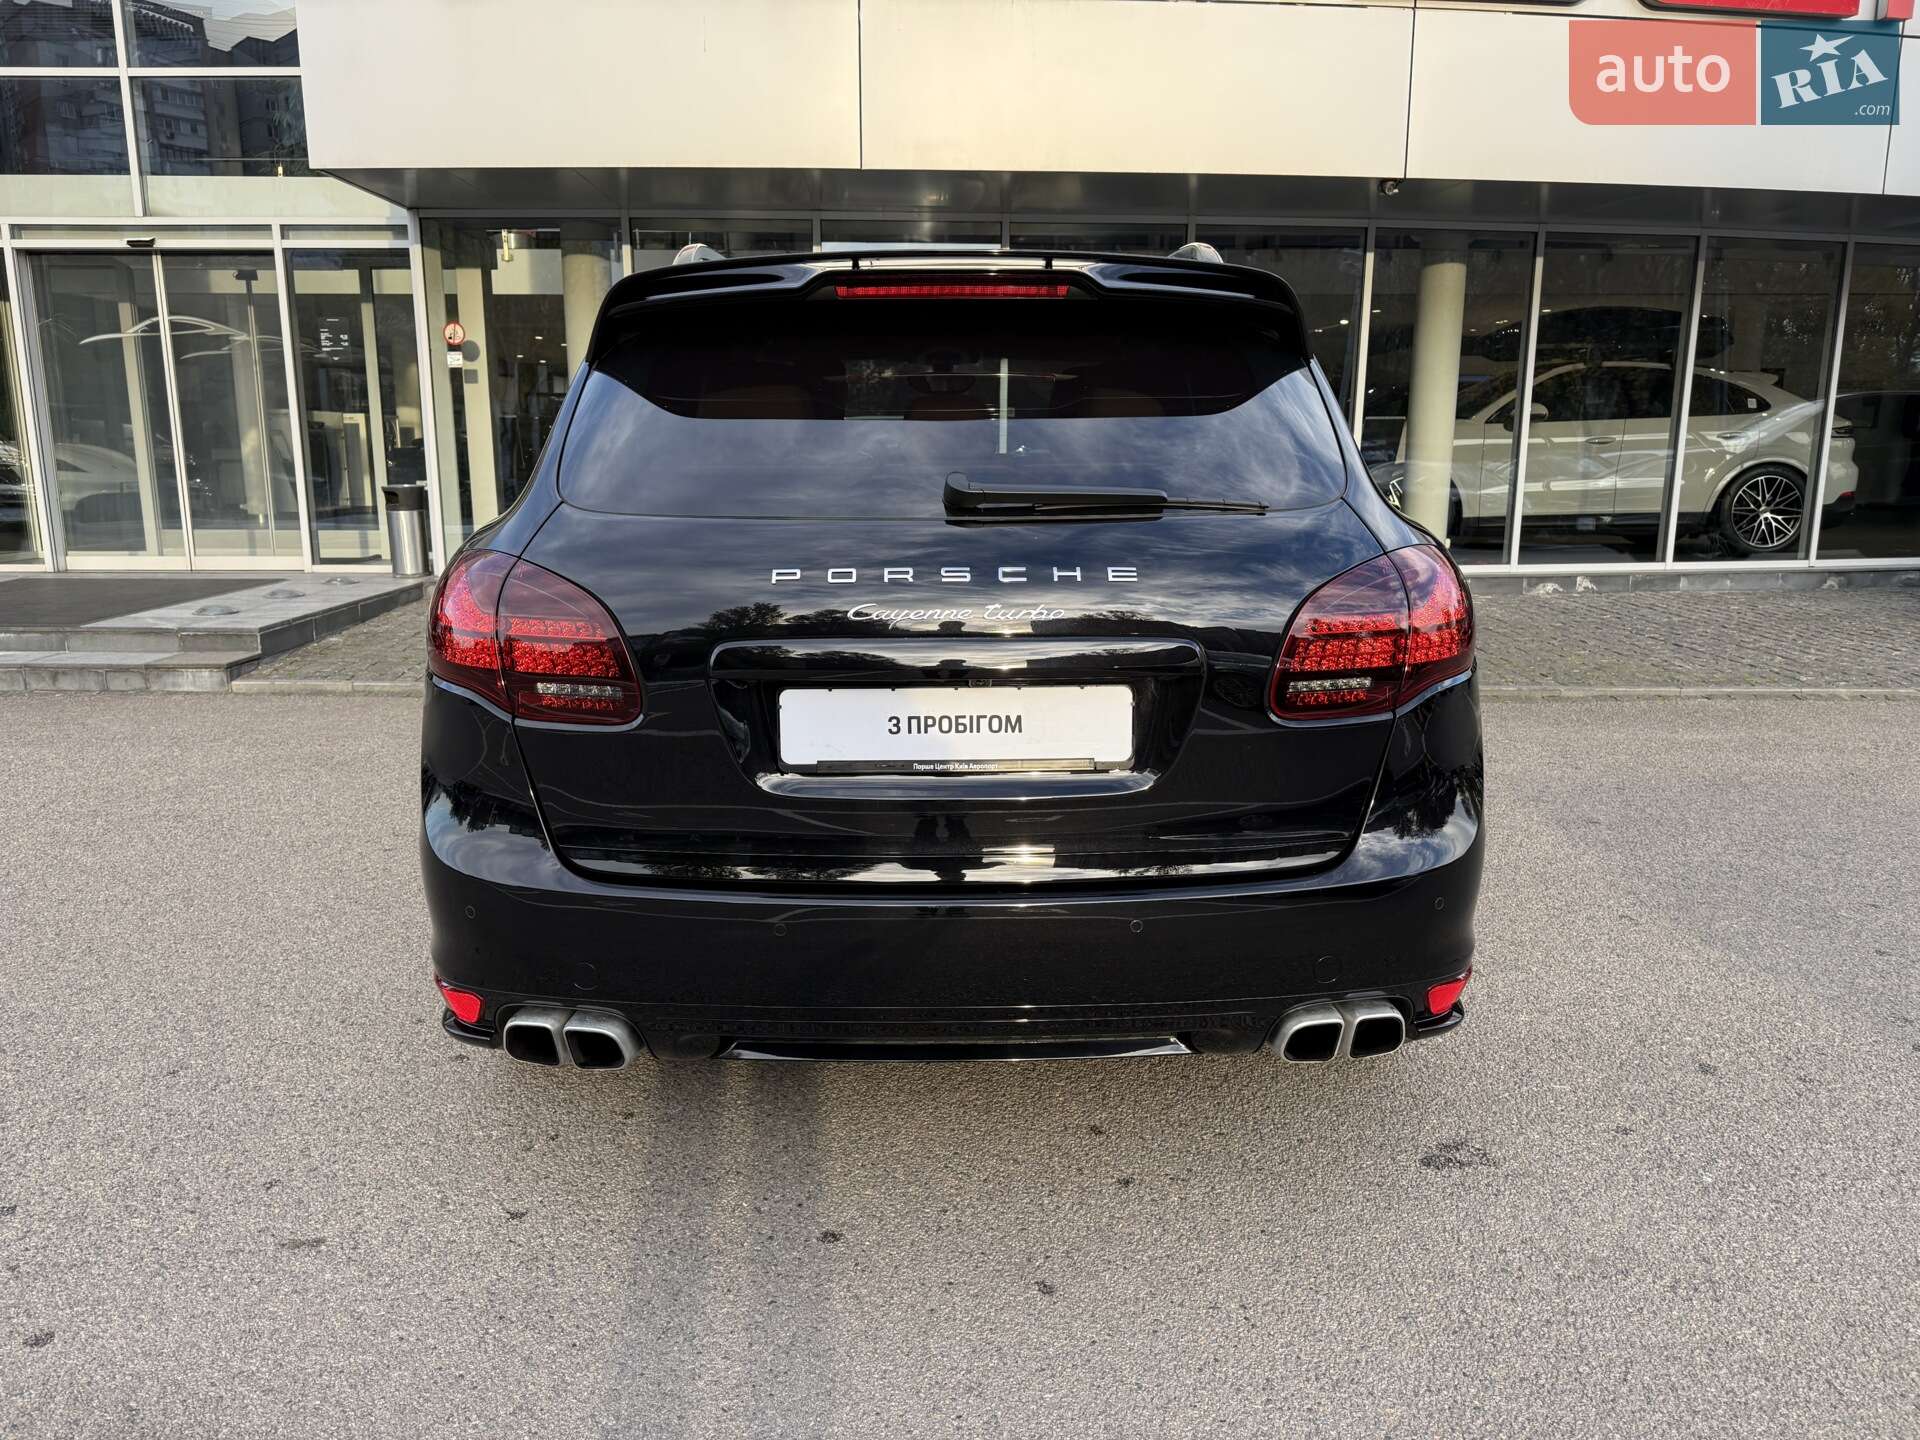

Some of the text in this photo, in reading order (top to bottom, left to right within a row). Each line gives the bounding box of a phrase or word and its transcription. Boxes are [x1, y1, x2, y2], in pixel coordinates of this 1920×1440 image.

[771, 566, 1138, 584] PORSCHE
[847, 603, 1065, 630] Cayenne turbo
[907, 714, 1023, 735] ПРОБІГОМ
[912, 763, 934, 771] Порше
